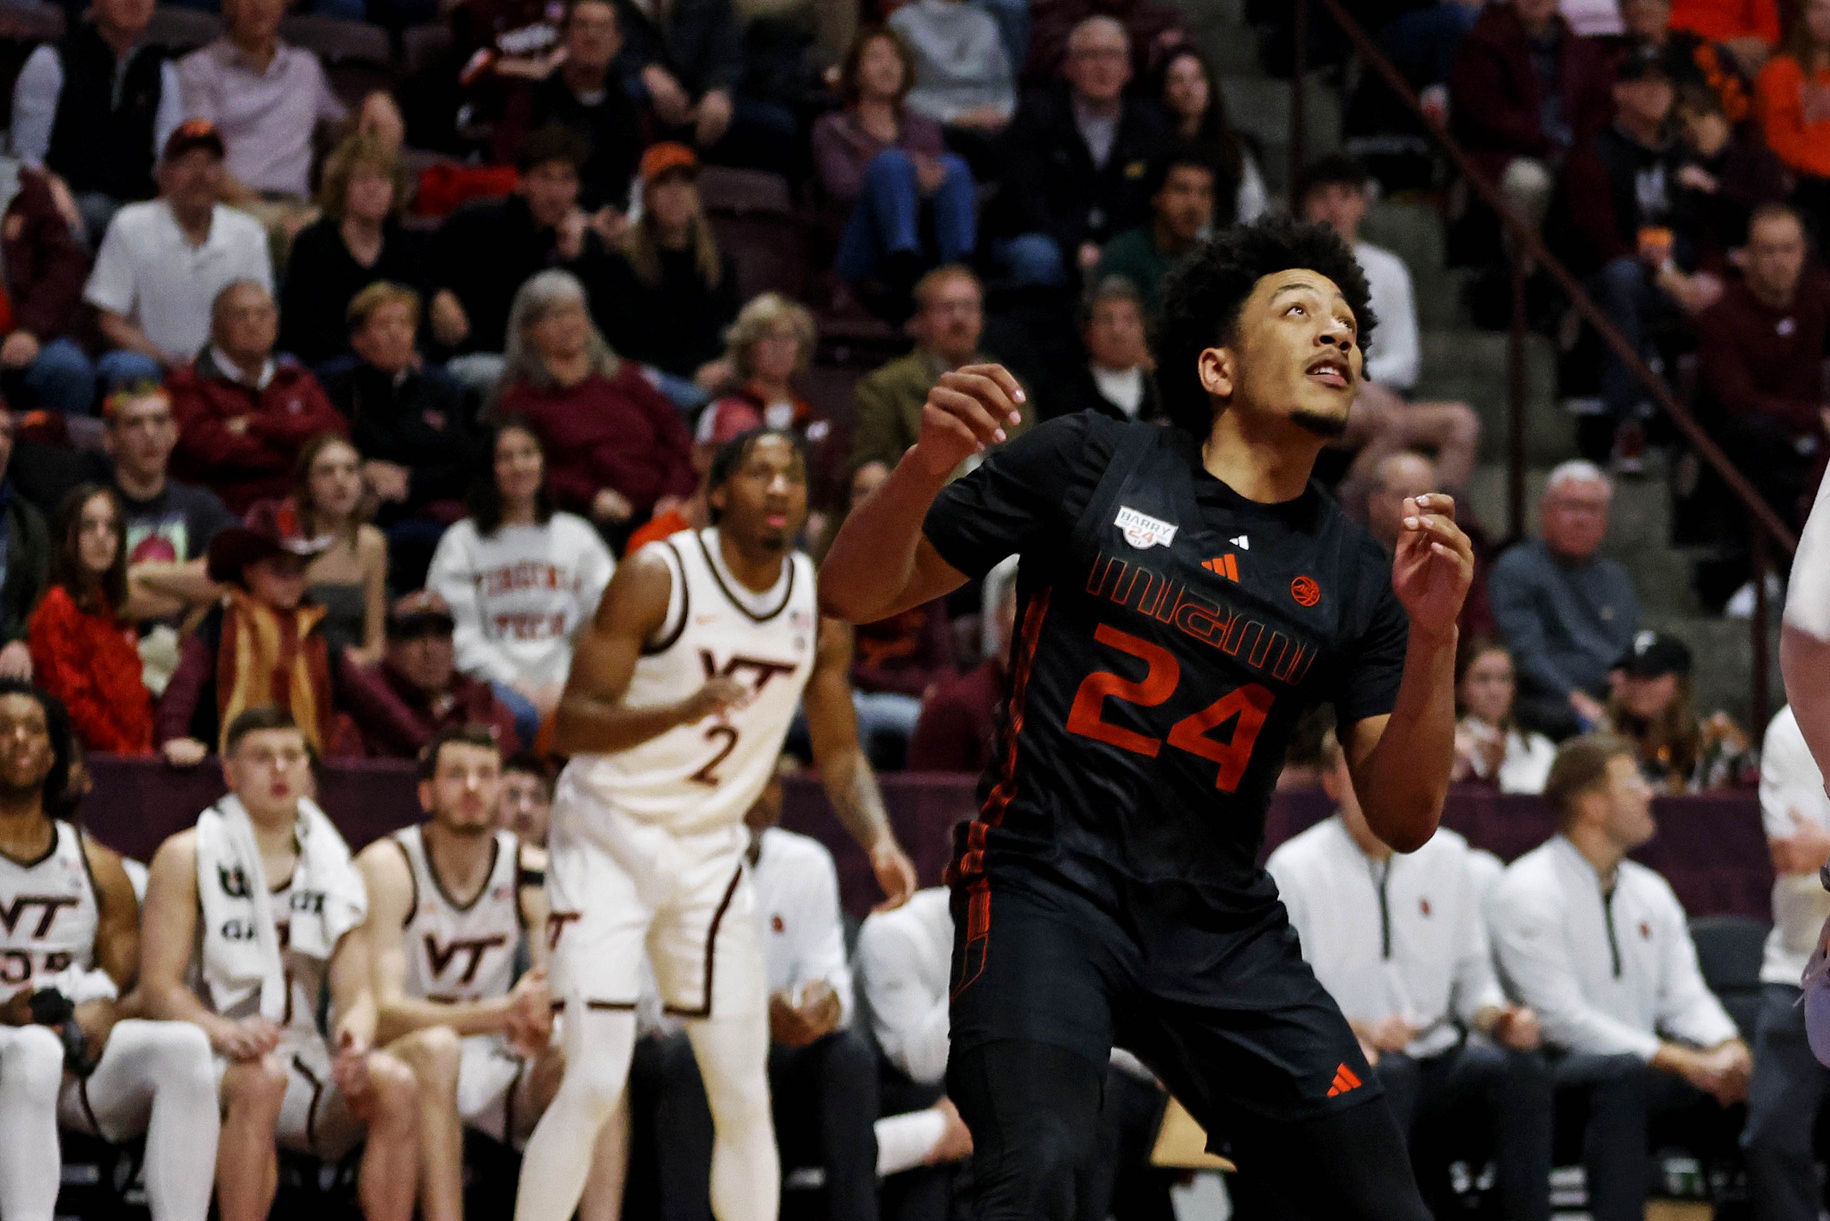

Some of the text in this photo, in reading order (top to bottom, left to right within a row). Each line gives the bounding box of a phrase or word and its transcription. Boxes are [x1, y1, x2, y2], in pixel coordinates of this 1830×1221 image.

[1119, 510, 1173, 537] BARRY
[1126, 525, 1157, 545] 24
[1065, 621, 1277, 794] 24
[686, 723, 740, 788] 2
[422, 931, 507, 986] VT
